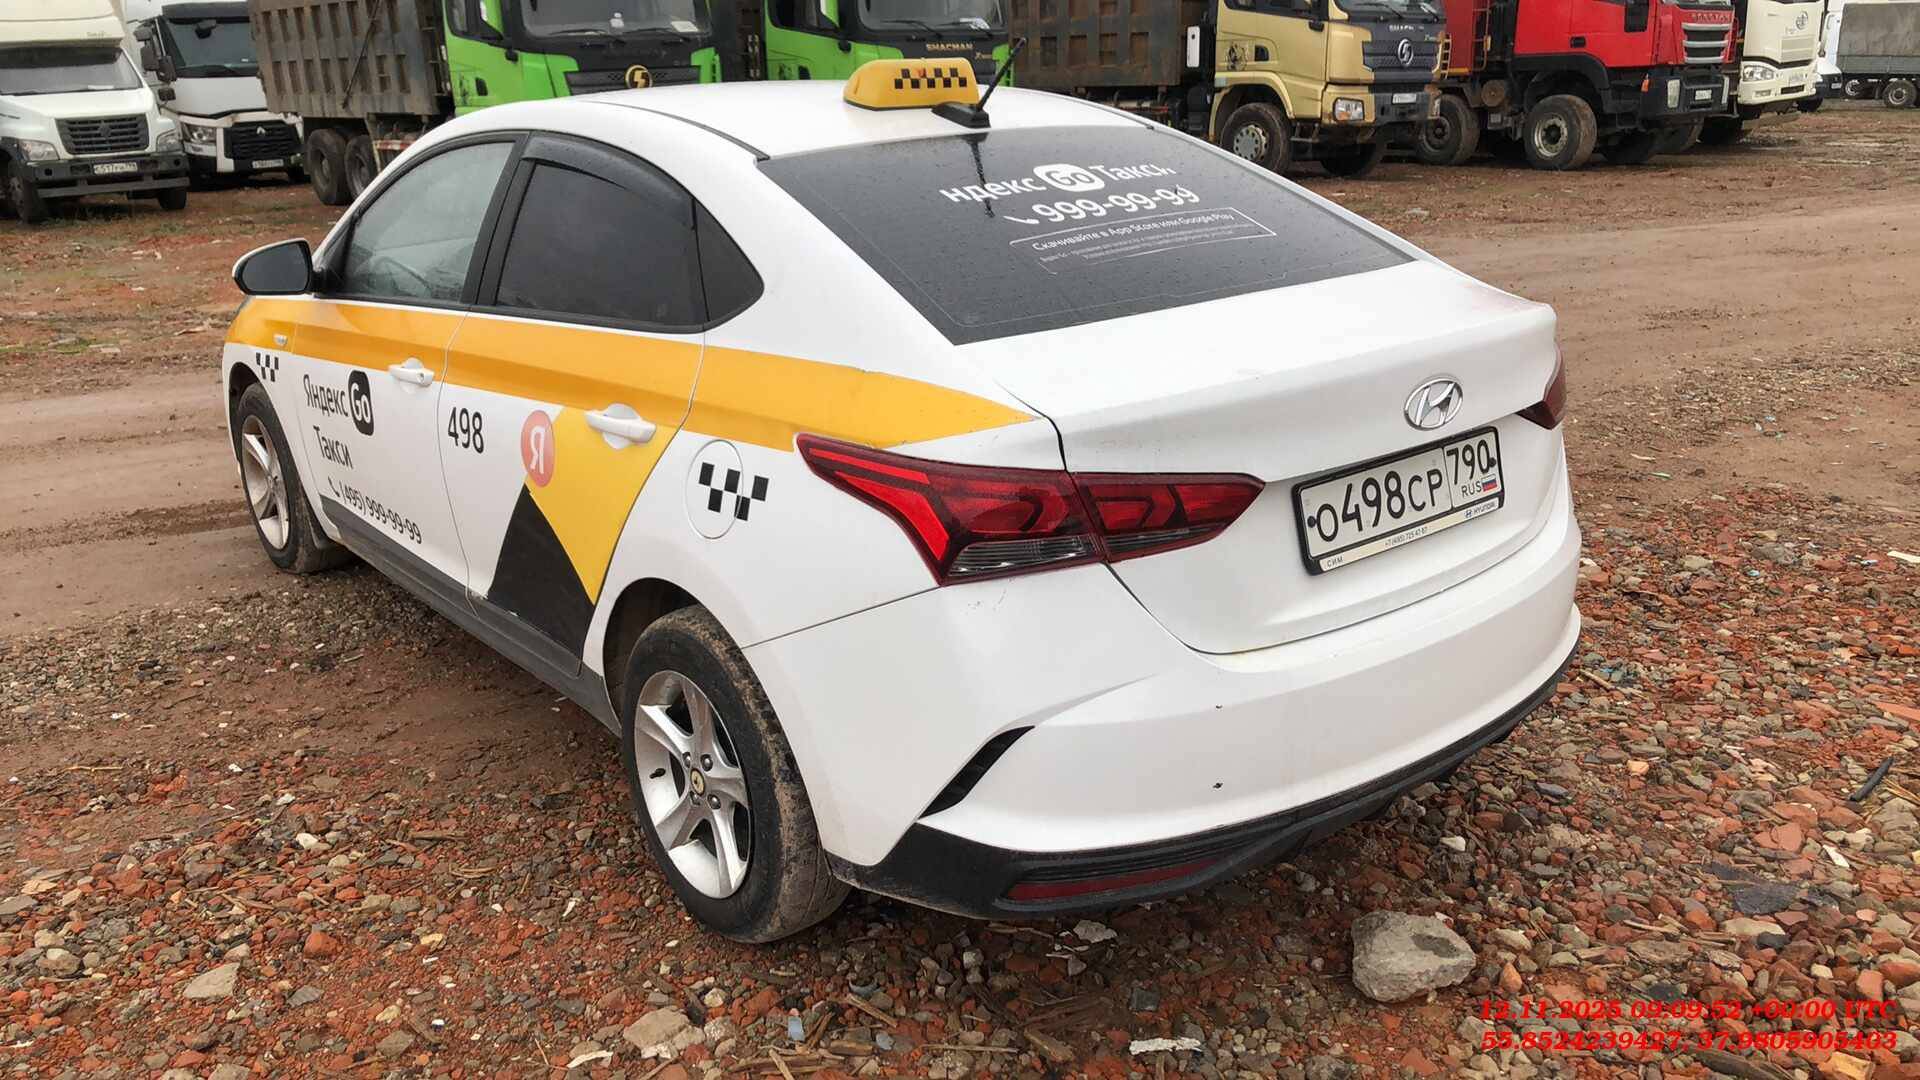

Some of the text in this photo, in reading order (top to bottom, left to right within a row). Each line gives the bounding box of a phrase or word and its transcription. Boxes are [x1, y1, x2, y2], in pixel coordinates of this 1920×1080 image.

[1045, 170, 1096, 186] Go
[1032, 184, 1200, 222] 999-99-99
[1032, 232, 1100, 250] Скачивайте
[303, 374, 372, 424] Яндекс Go
[313, 425, 354, 469] Такси
[447, 406, 485, 454] 498
[1446, 439, 1491, 486] 790
[1461, 481, 1482, 499] RUS
[339, 481, 422, 544] (495) 999-99-99
[1327, 556, 1344, 569] СИМ
